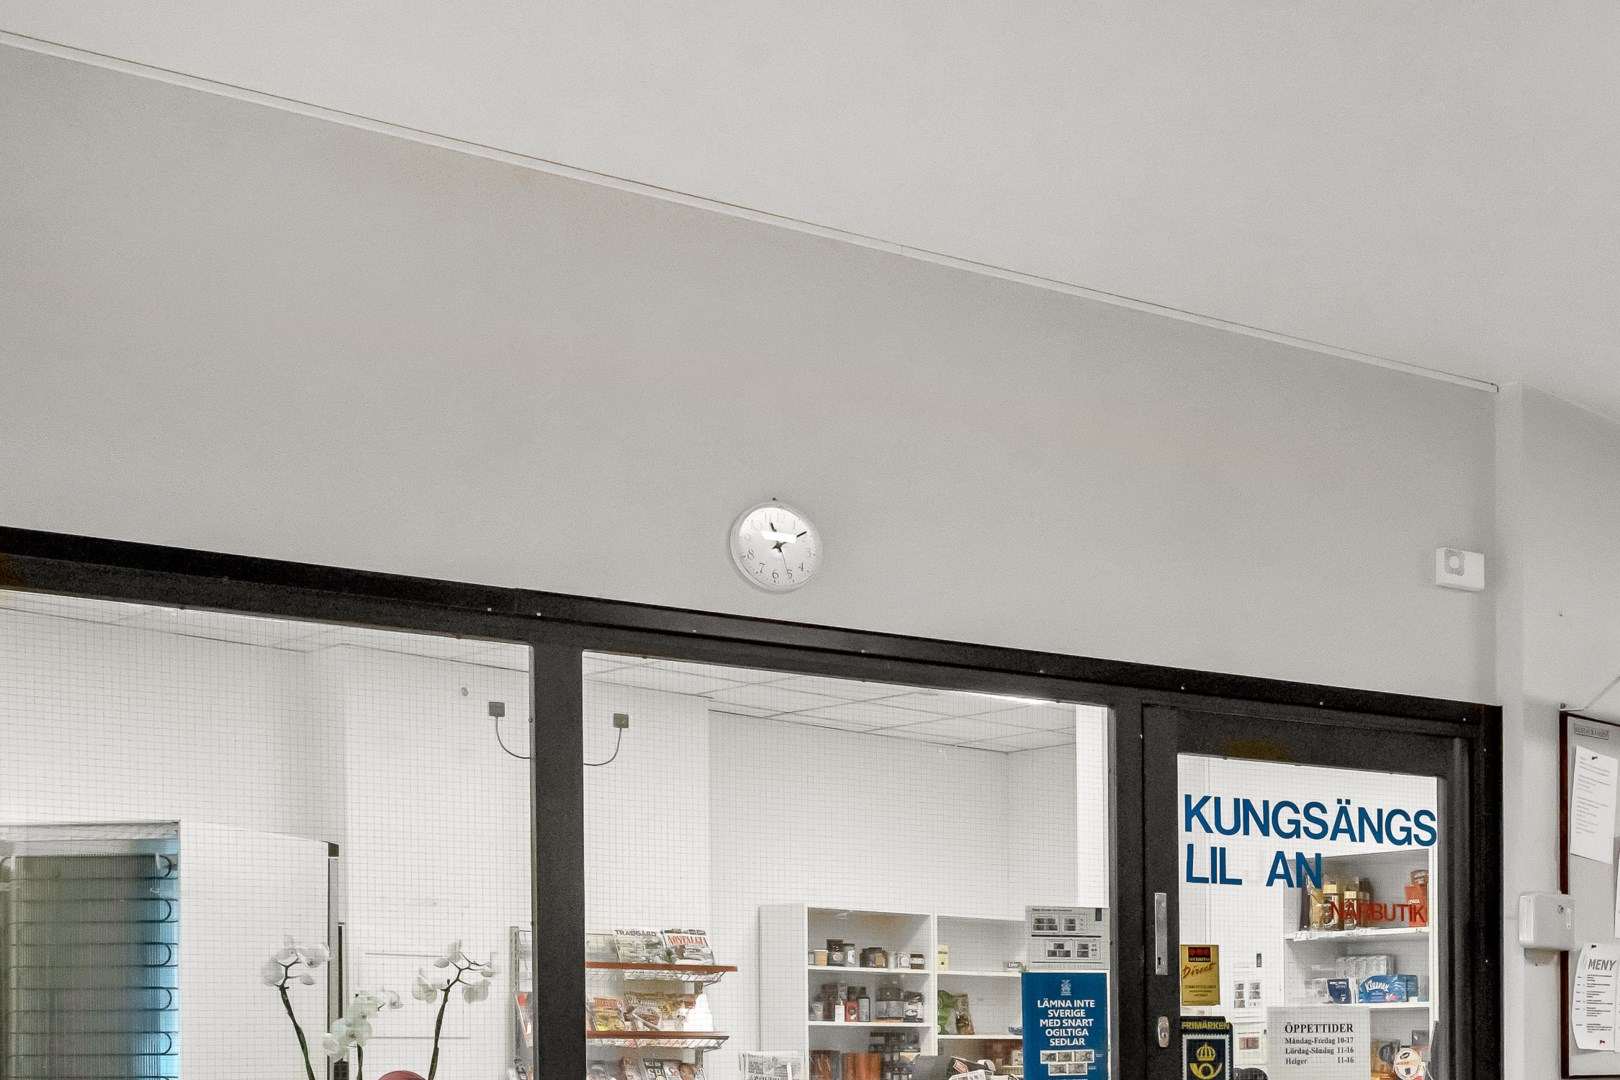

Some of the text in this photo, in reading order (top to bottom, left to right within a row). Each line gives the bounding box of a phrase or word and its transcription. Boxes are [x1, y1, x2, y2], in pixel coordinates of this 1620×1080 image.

[1184, 794, 1436, 846] KUNGSÄNGS
[1186, 844, 1322, 888] LIL AN
[1588, 958, 1617, 971] MENY
[1183, 962, 1217, 979] Direct
[1365, 979, 1389, 992] Kleenex
[1037, 998, 1095, 1008] LÄMNA INTE
[1047, 1009, 1086, 1018] SVERIGE
[1040, 1018, 1094, 1027] MED SNART
[1182, 1021, 1230, 1031] FRIMÄRKEN
[1284, 1021, 1354, 1034] ÖPPETTIDER
[1045, 1028, 1089, 1037] OGILTIGA
[1050, 1038, 1086, 1046] SEDLAR
[1285, 1037, 1335, 1045] Måndag-Fredag
[1337, 1046, 1354, 1054] 11-16
[1285, 1057, 1308, 1065] Helger
